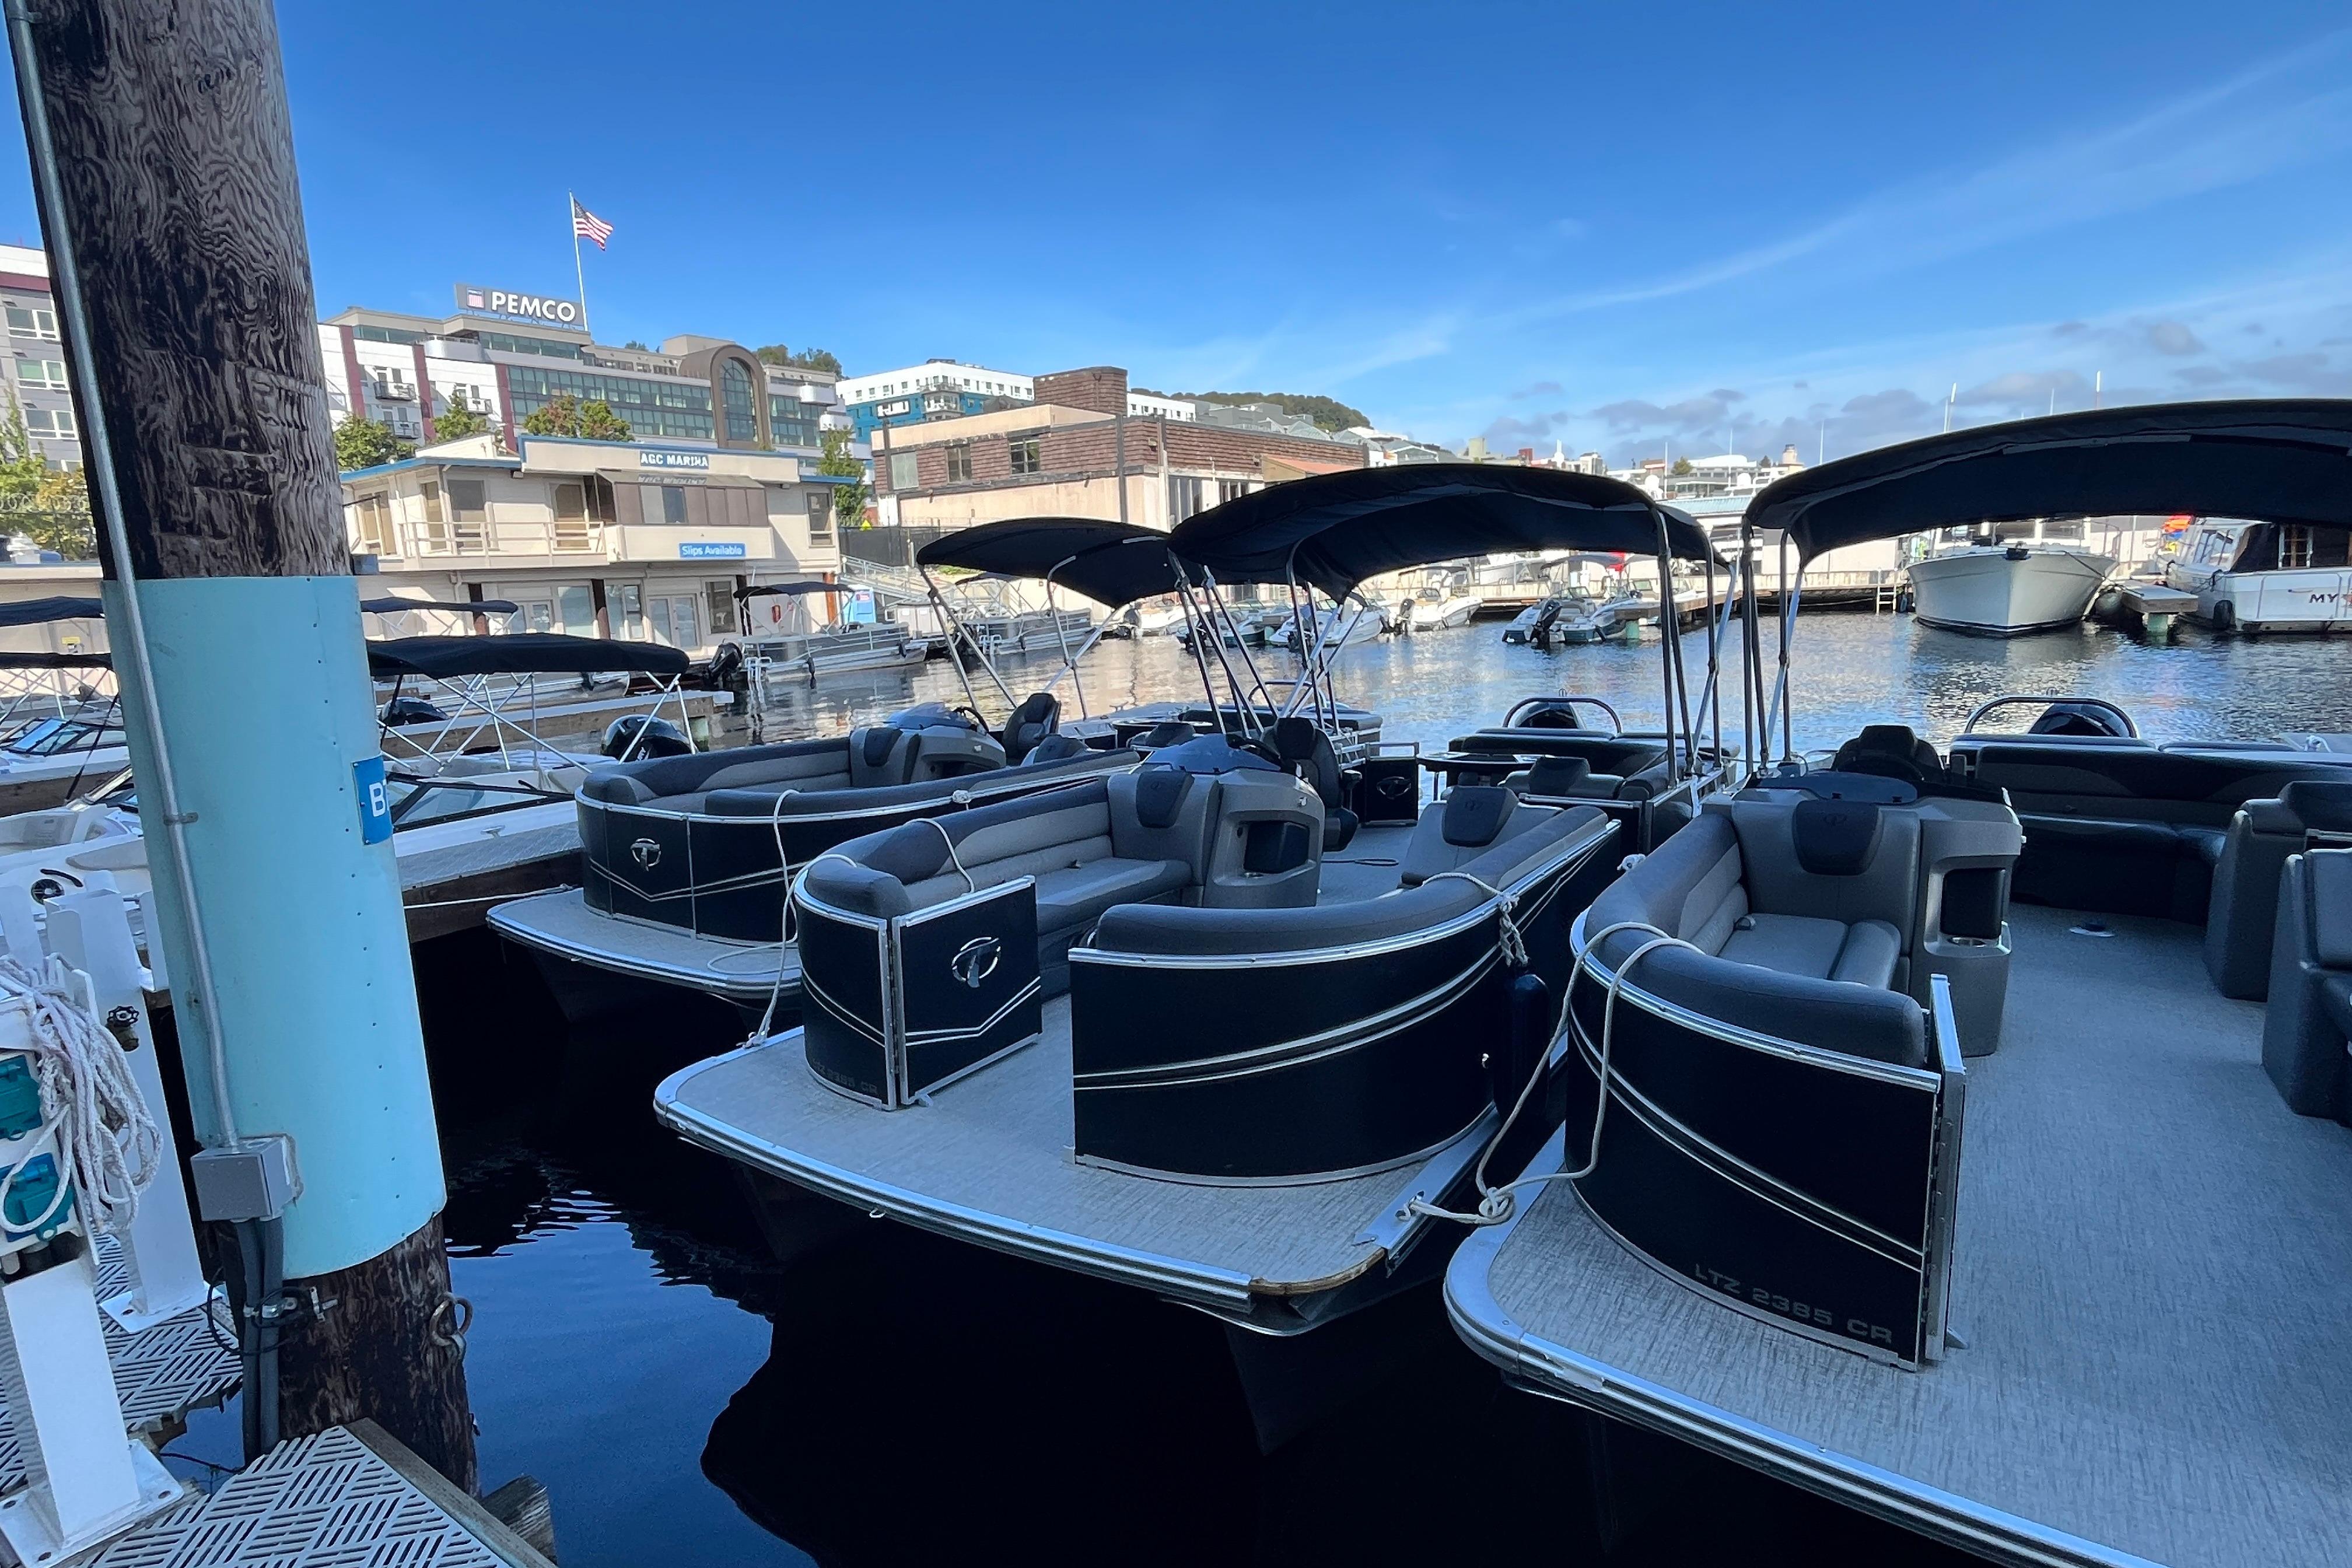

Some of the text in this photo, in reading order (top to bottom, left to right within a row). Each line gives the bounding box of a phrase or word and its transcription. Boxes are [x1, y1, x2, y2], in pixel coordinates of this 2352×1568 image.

[491, 291, 575, 322] PEMCO
[641, 453, 663, 464] AGC
[682, 545, 742, 556] Slips Available
[369, 779, 390, 817] B
[1696, 1264, 1892, 1344] LTZ 2385 CR
